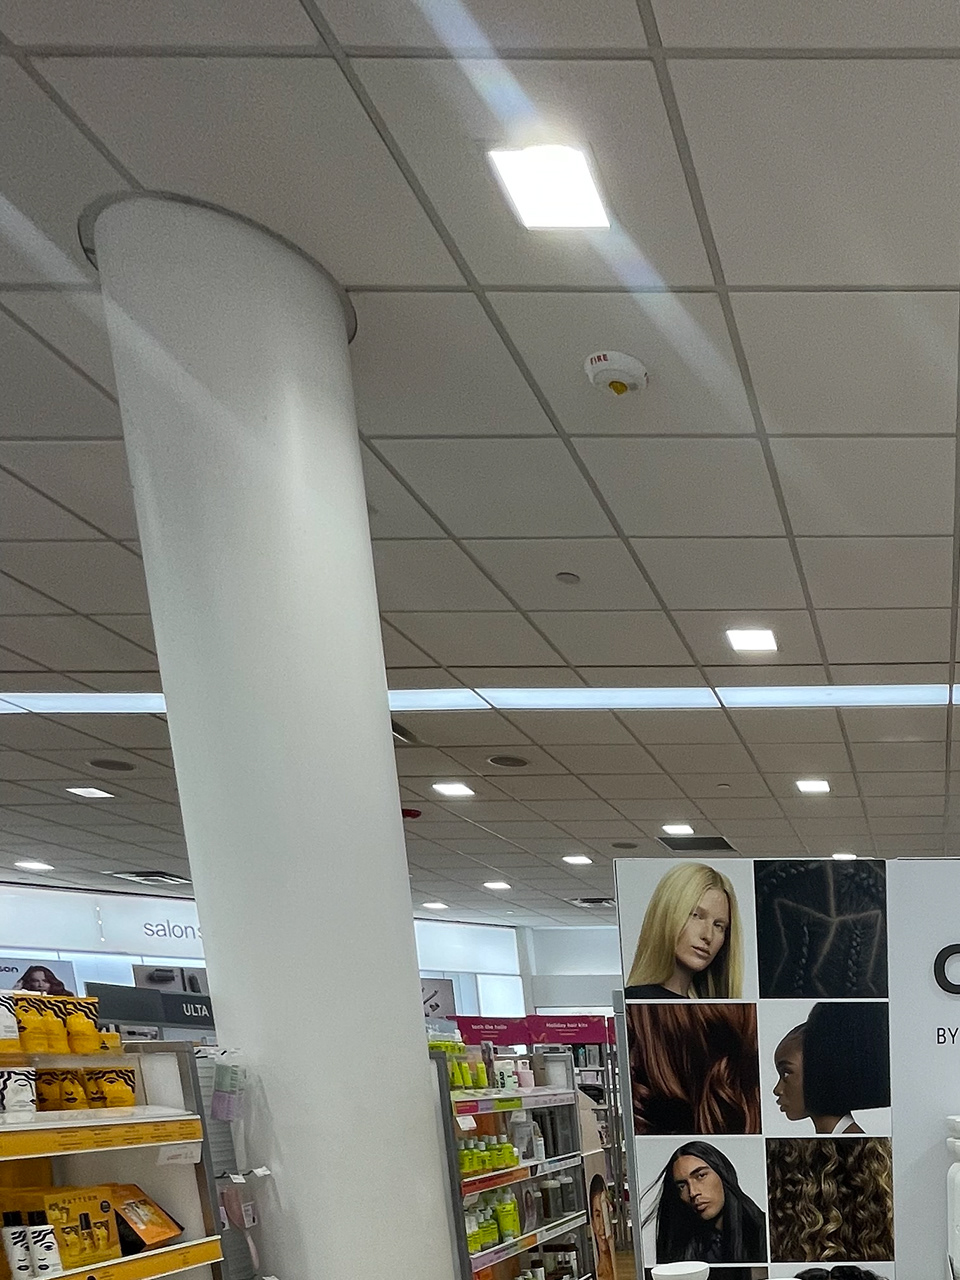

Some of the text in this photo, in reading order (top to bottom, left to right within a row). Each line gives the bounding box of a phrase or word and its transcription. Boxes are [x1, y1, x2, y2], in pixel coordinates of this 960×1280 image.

[590, 354, 608, 365] FIRE
[182, 1003, 210, 1018] ULTA
[936, 1027, 959, 1045] BY
